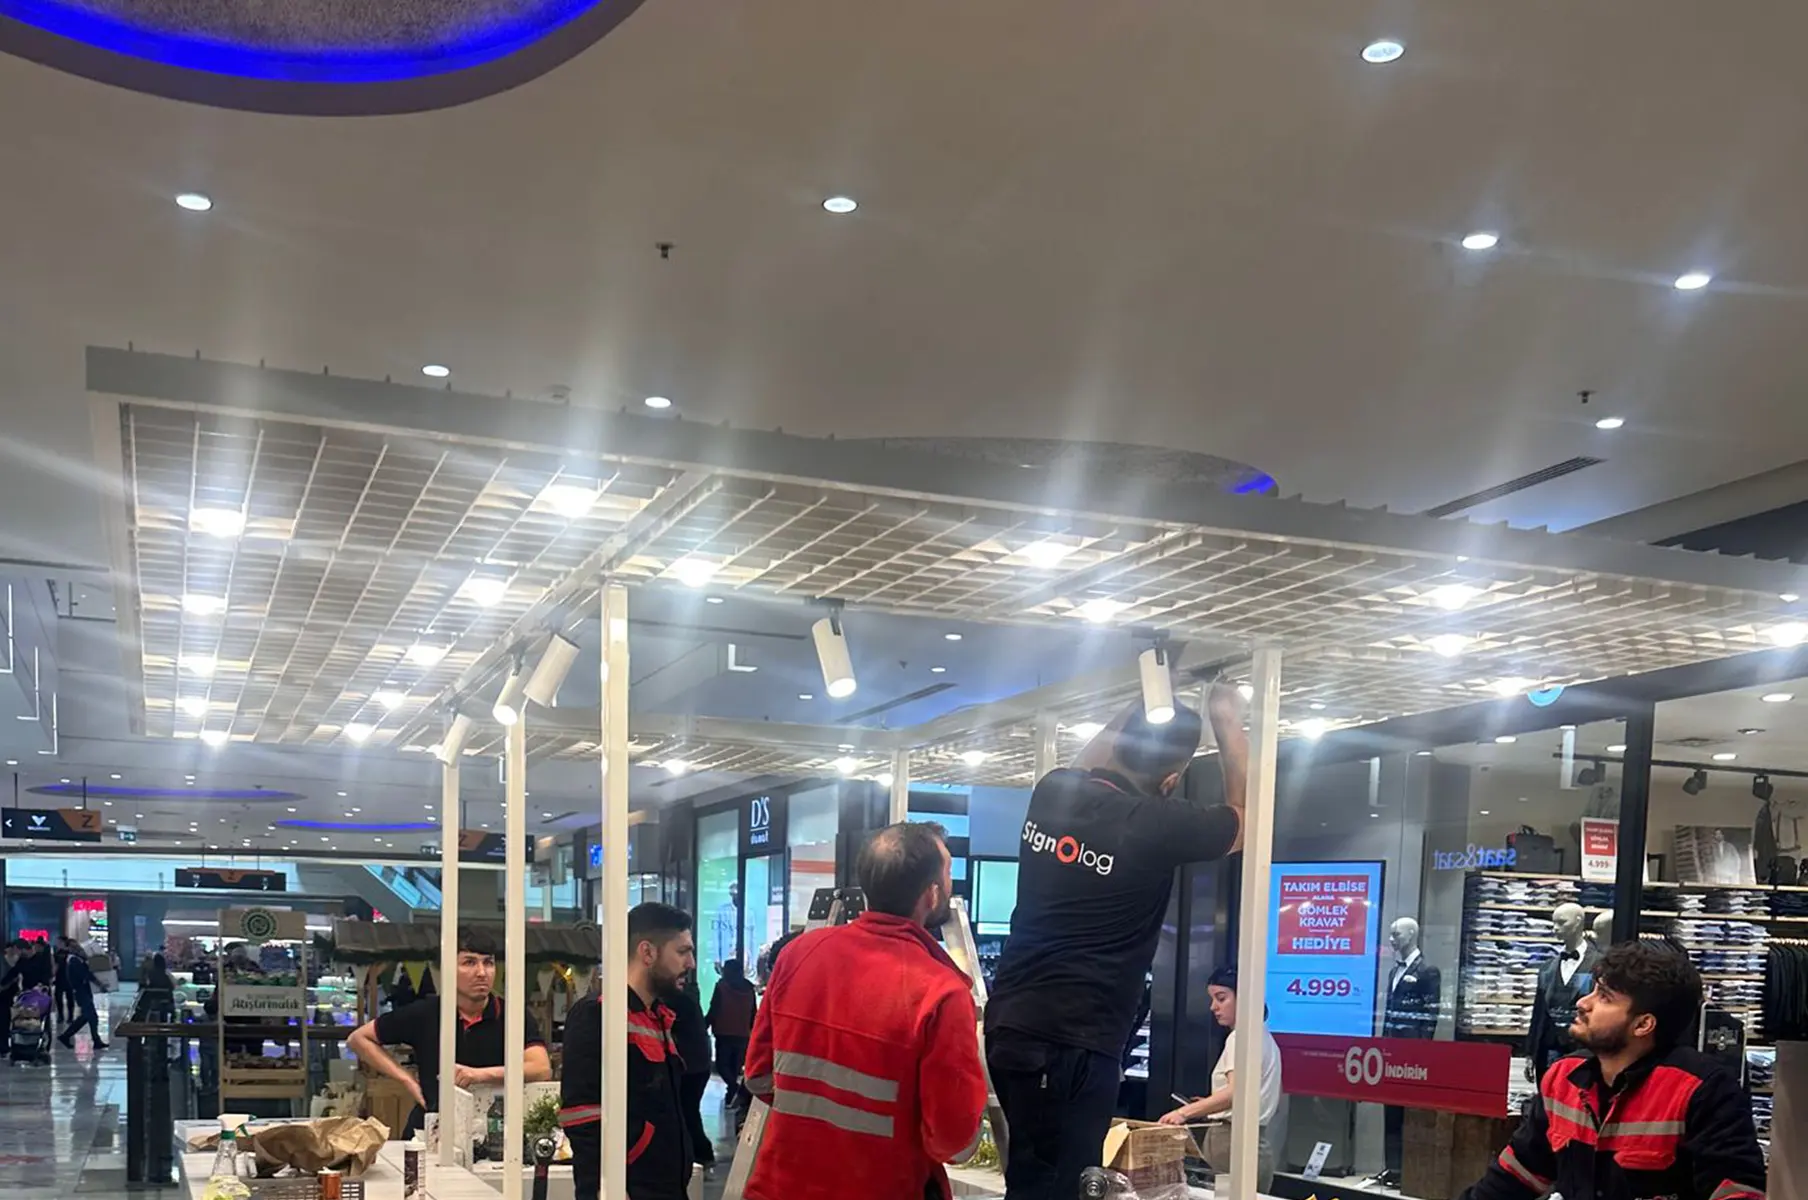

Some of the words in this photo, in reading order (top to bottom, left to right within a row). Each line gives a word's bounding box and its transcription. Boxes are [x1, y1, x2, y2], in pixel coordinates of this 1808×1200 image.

[751, 797, 770, 827] D'S
[82, 815, 93, 827] Z
[1283, 882, 1320, 892] TAKIM
[1323, 880, 1367, 892] ELBİSE
[1299, 917, 1346, 927] KRAVAT
[1292, 935, 1351, 950] HEDİYE
[1286, 978, 1351, 996] 4.999
[1384, 1062, 1428, 1080] İNDİRİM
